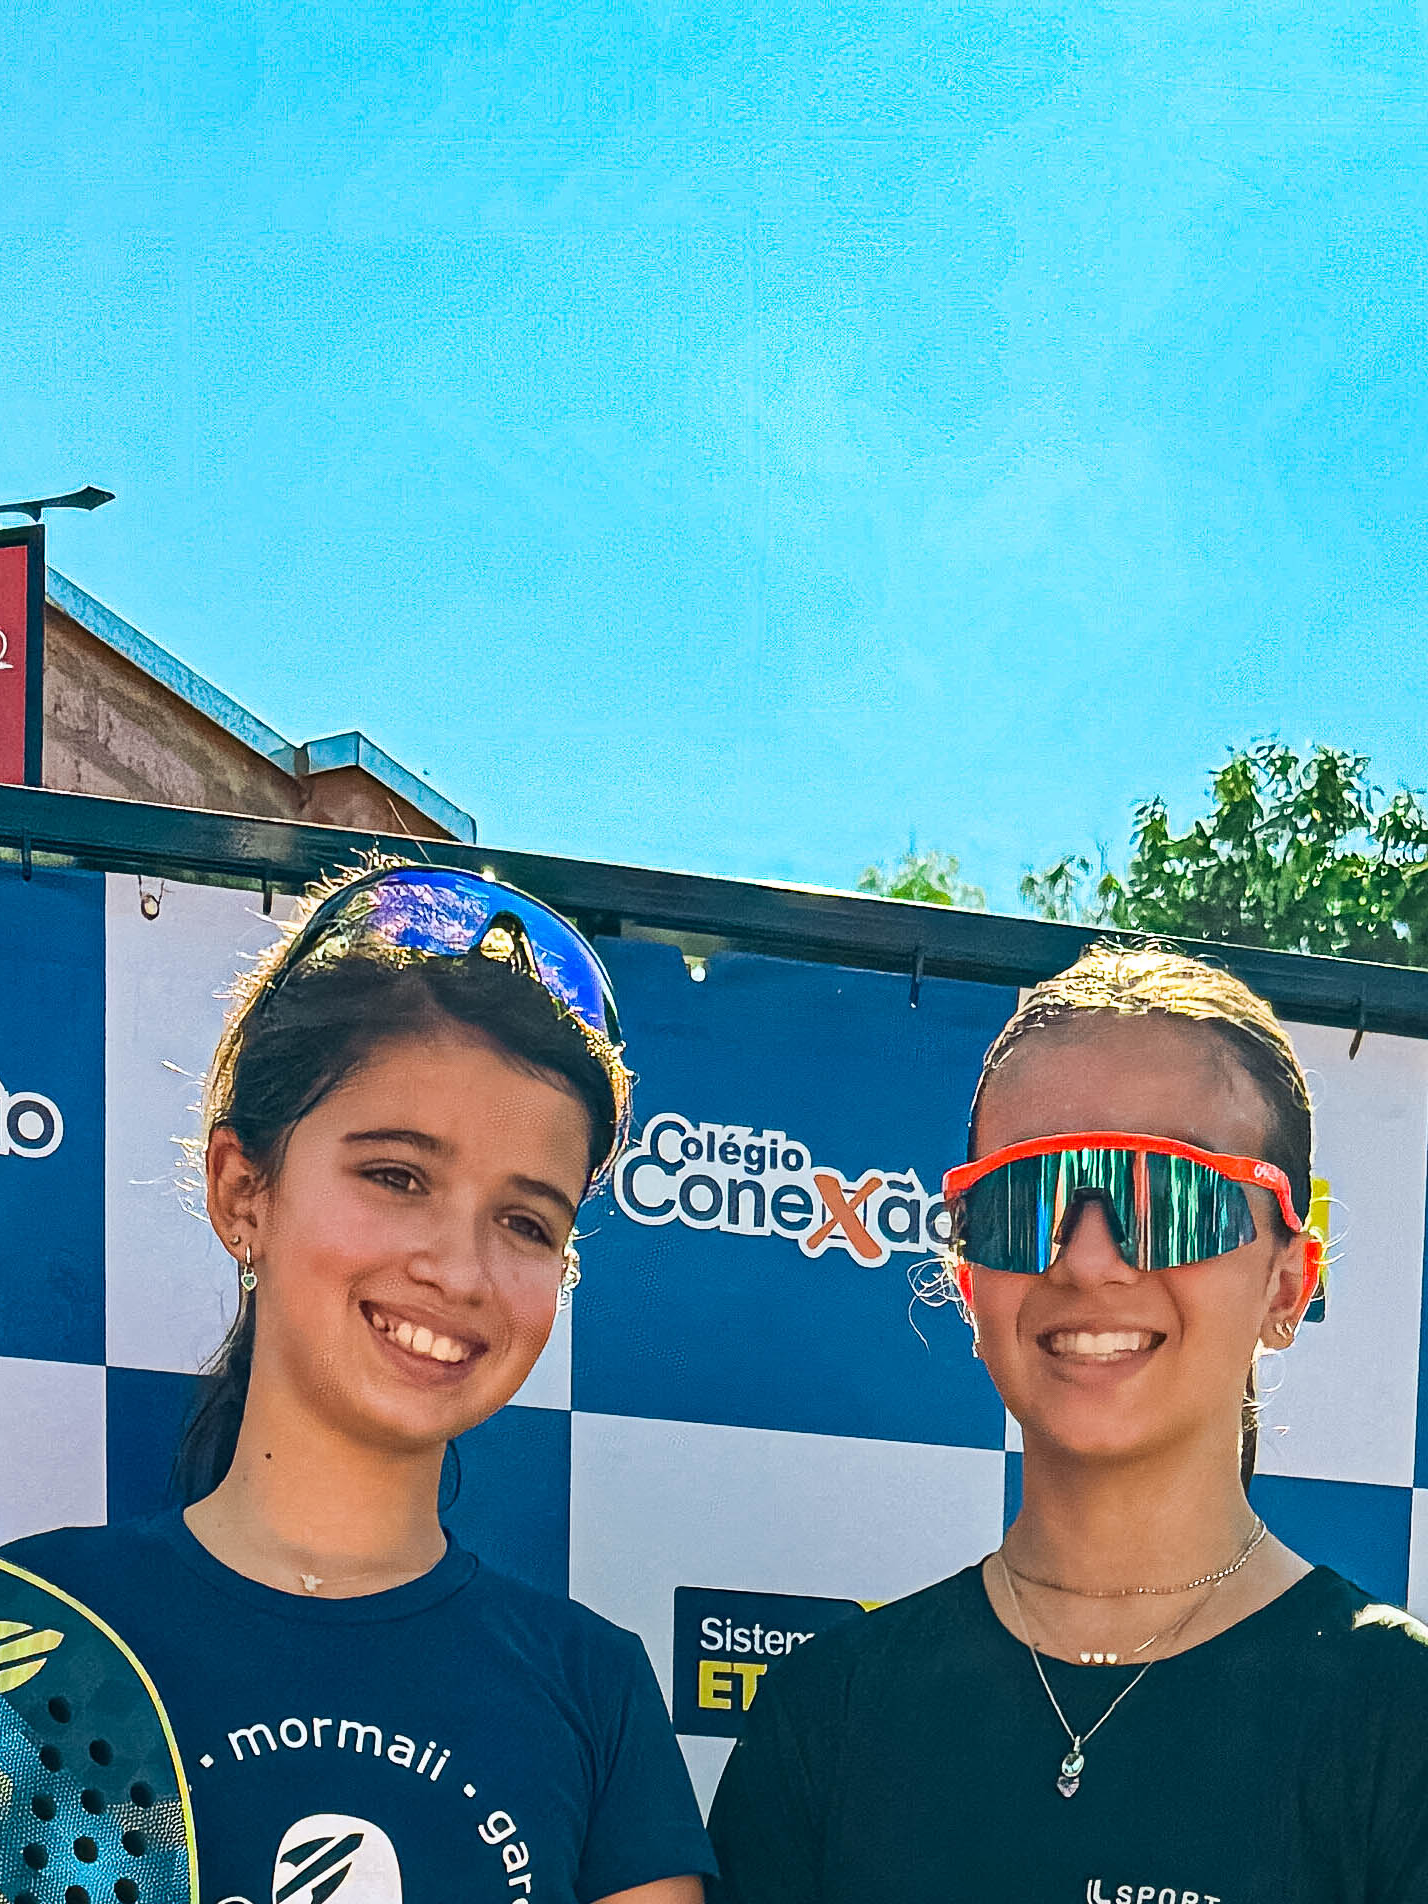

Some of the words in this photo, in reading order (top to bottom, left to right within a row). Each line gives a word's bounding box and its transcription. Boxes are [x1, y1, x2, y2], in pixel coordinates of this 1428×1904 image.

[651, 1120, 804, 1174] Colégio
[700, 1617, 814, 1655] Siste
[228, 1718, 450, 1781] mormaii
